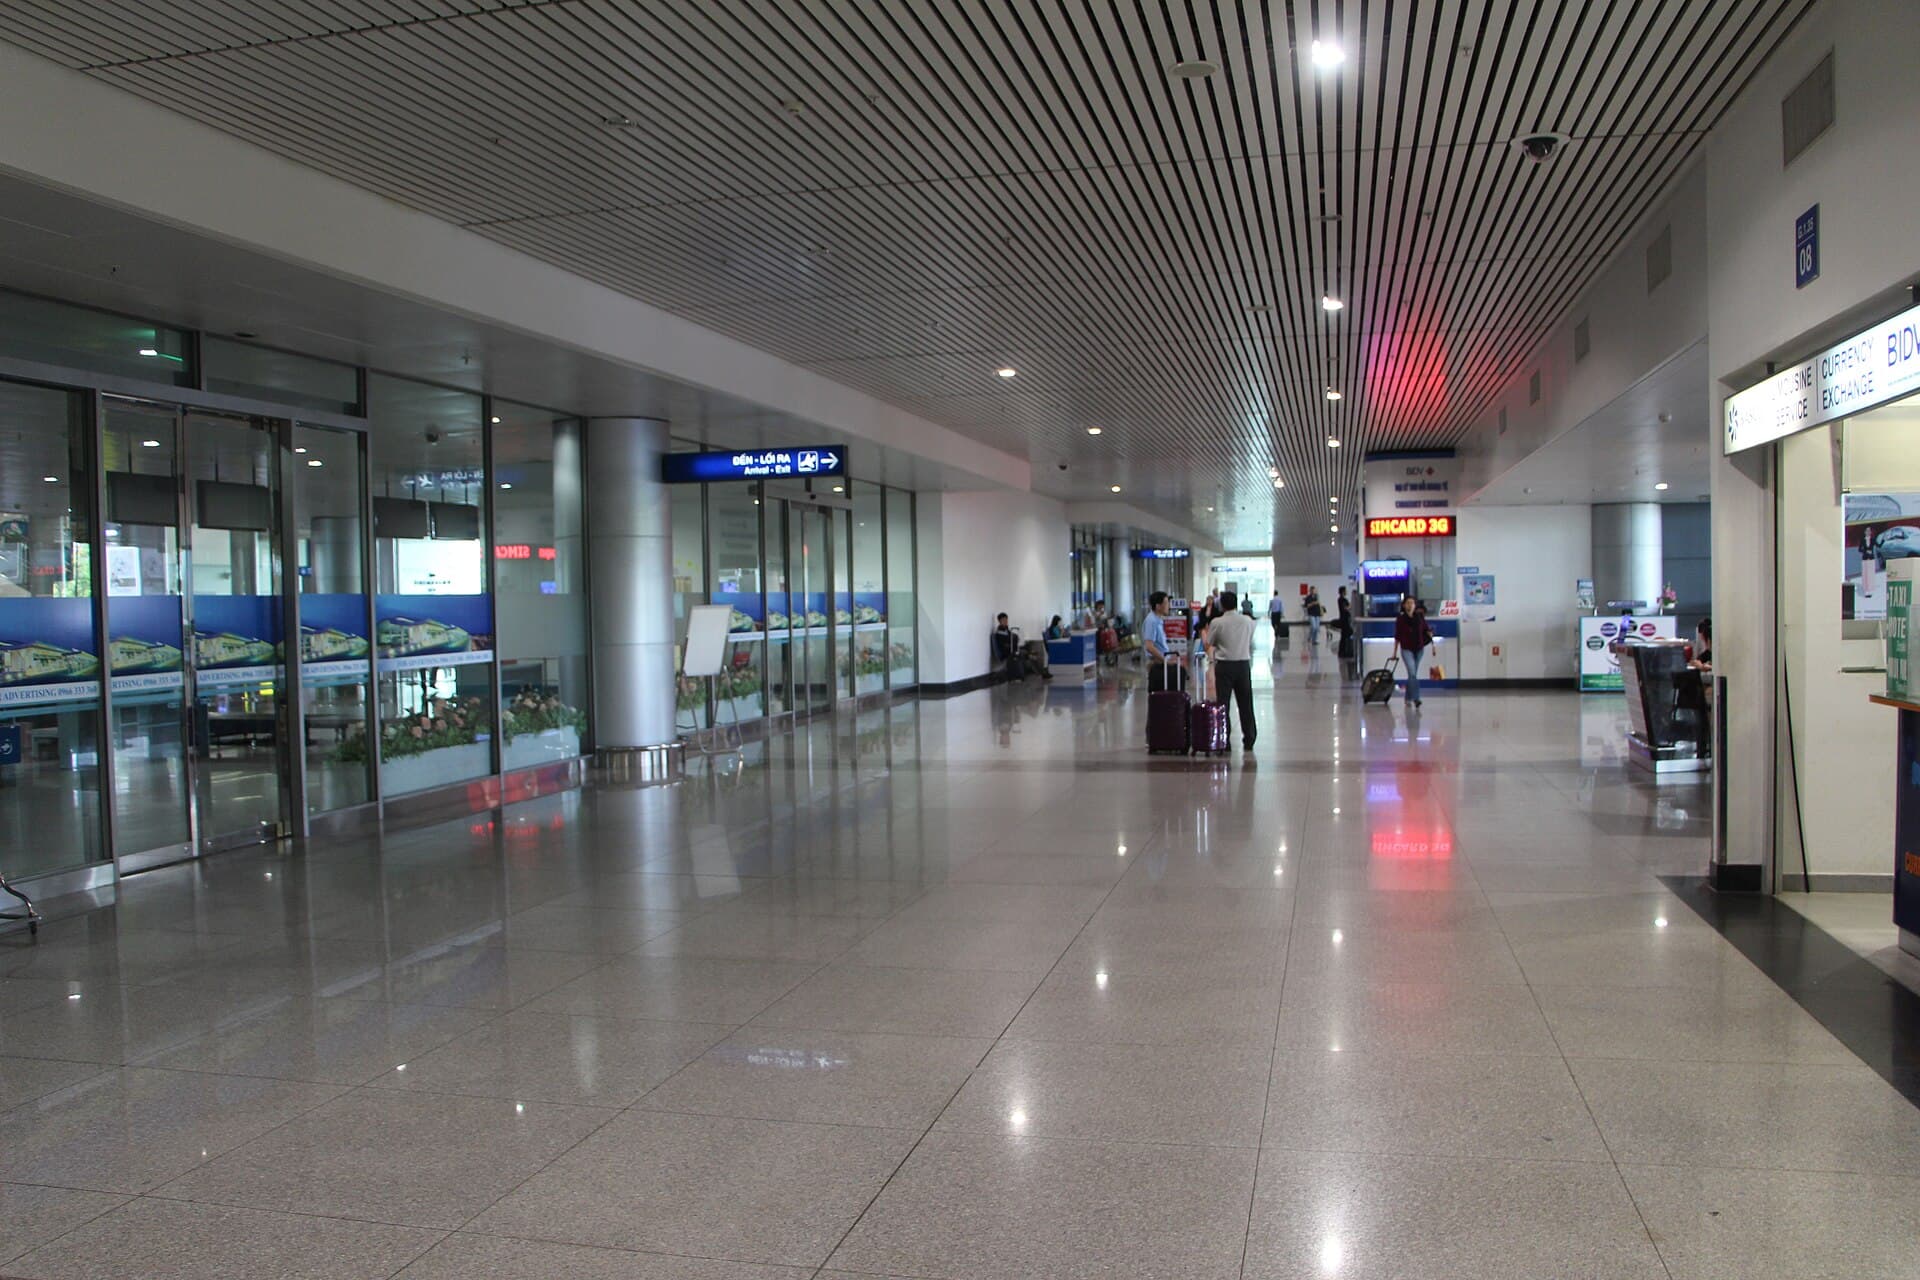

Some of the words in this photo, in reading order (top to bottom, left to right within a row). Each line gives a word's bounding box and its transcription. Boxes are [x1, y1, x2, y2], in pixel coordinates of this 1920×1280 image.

[1800, 244, 1812, 276] 08
[1822, 337, 1874, 380] CURRENCY
[1822, 371, 1875, 410] EXCHANGE
[777, 453, 791, 464] RA
[744, 466, 769, 475] Arrival
[775, 465, 791, 474] Exit
[1370, 519, 1427, 535] SIMCARD
[1429, 518, 1448, 534] 3G
[1368, 568, 1405, 577] citibank
[1889, 586, 1907, 607] TAXI
[4, 687, 56, 700] ADVERTISING
